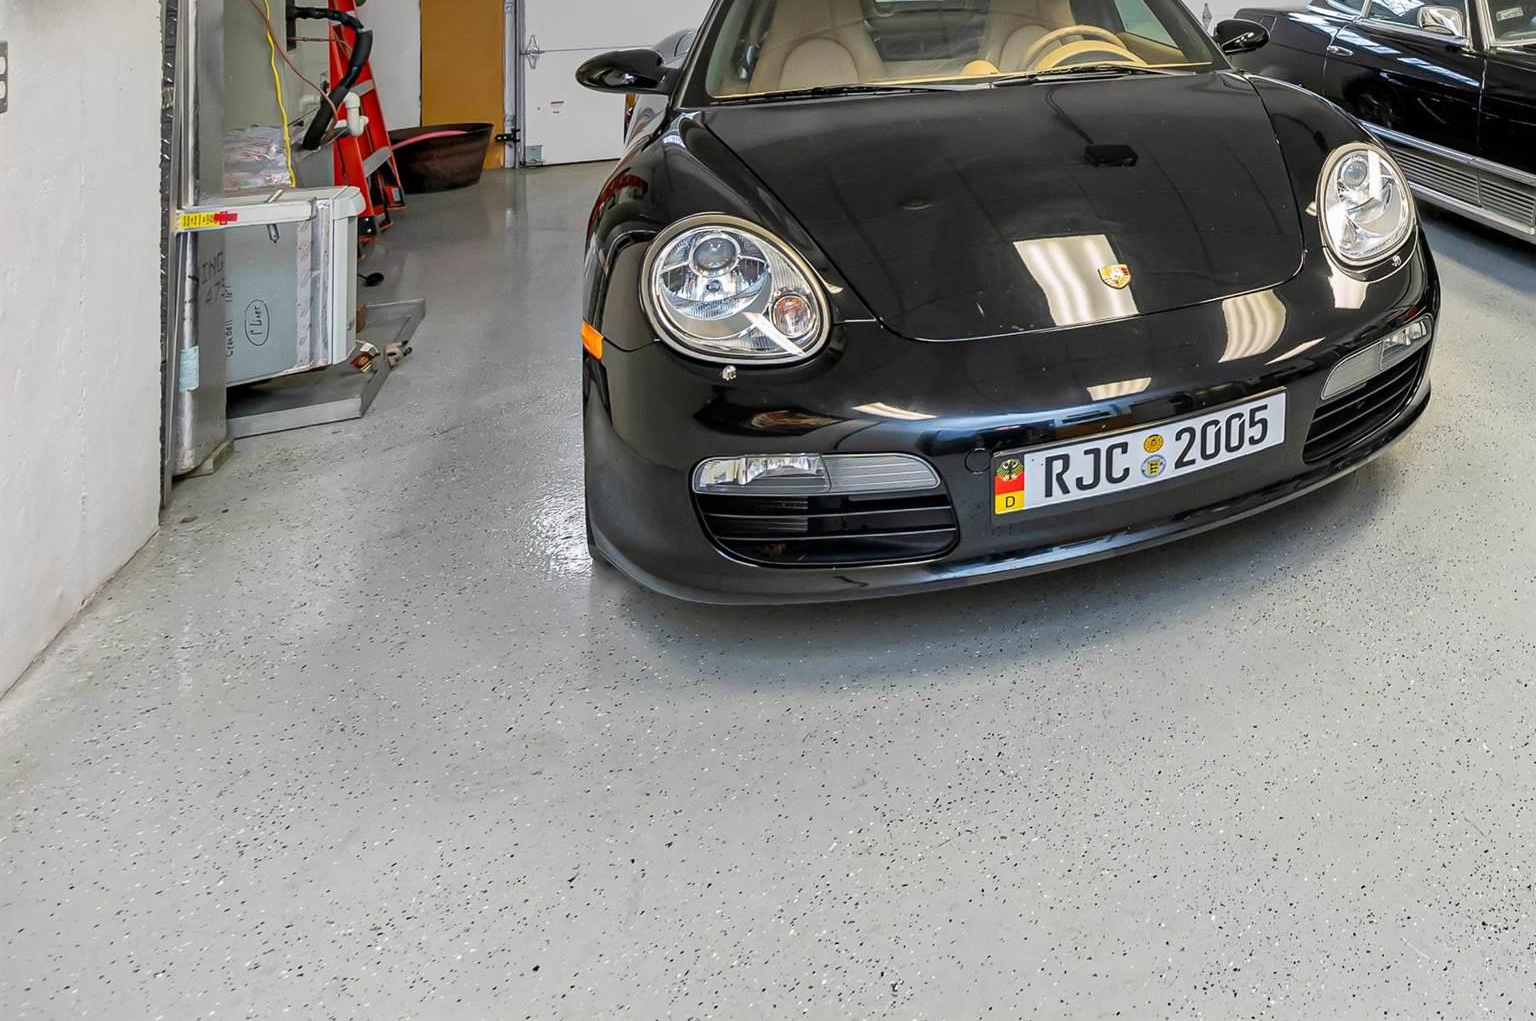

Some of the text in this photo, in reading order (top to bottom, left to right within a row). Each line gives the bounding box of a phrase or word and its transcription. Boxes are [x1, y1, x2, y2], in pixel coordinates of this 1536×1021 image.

[1043, 404, 1269, 499] RJC 2005
[1004, 495, 1016, 509] D
